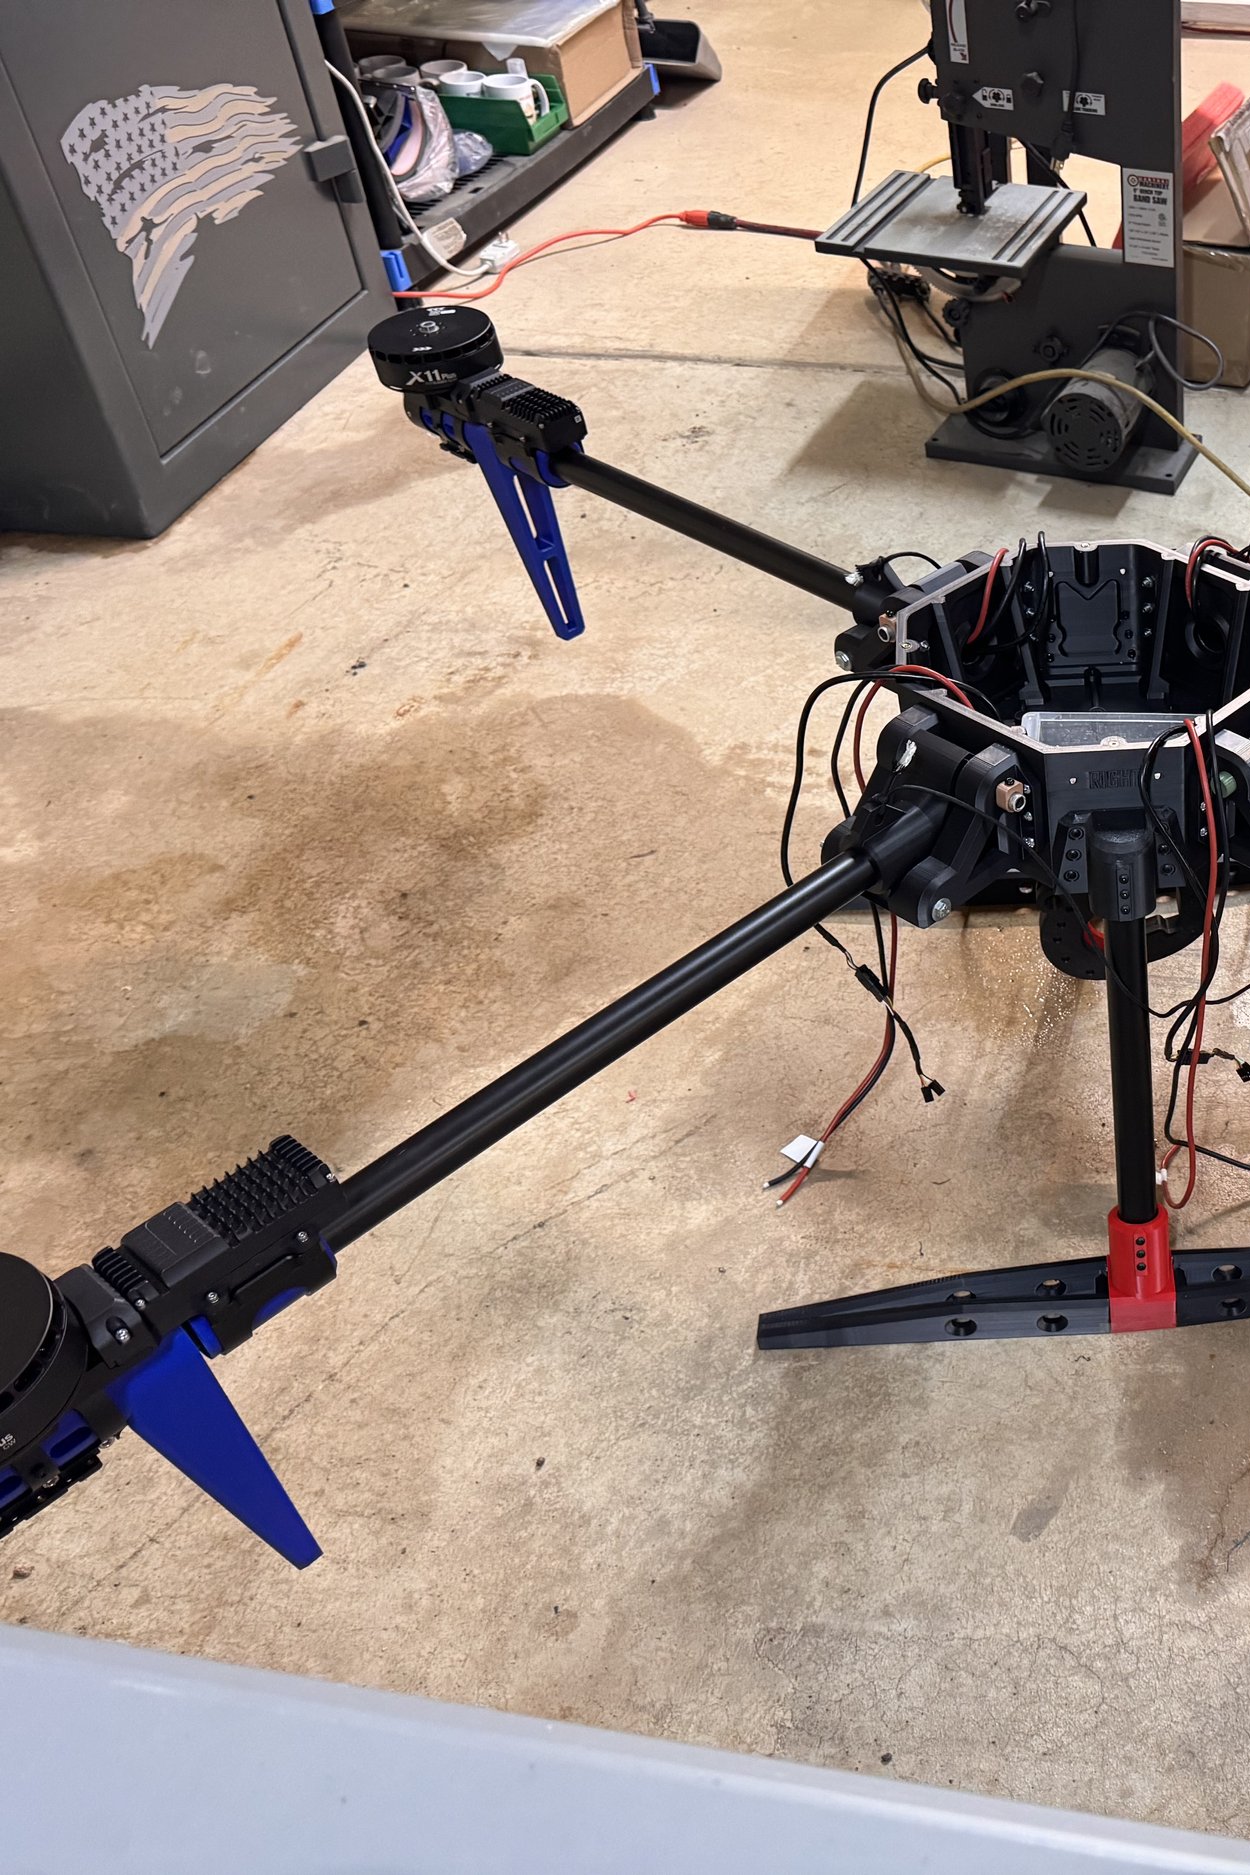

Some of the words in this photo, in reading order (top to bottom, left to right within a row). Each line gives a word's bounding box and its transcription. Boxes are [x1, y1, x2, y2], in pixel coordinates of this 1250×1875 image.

[1133, 194, 1151, 204] BAND
[1152, 195, 1167, 205] SAW
[405, 369, 441, 386] X11
[1088, 769, 1140, 790] RIGH
